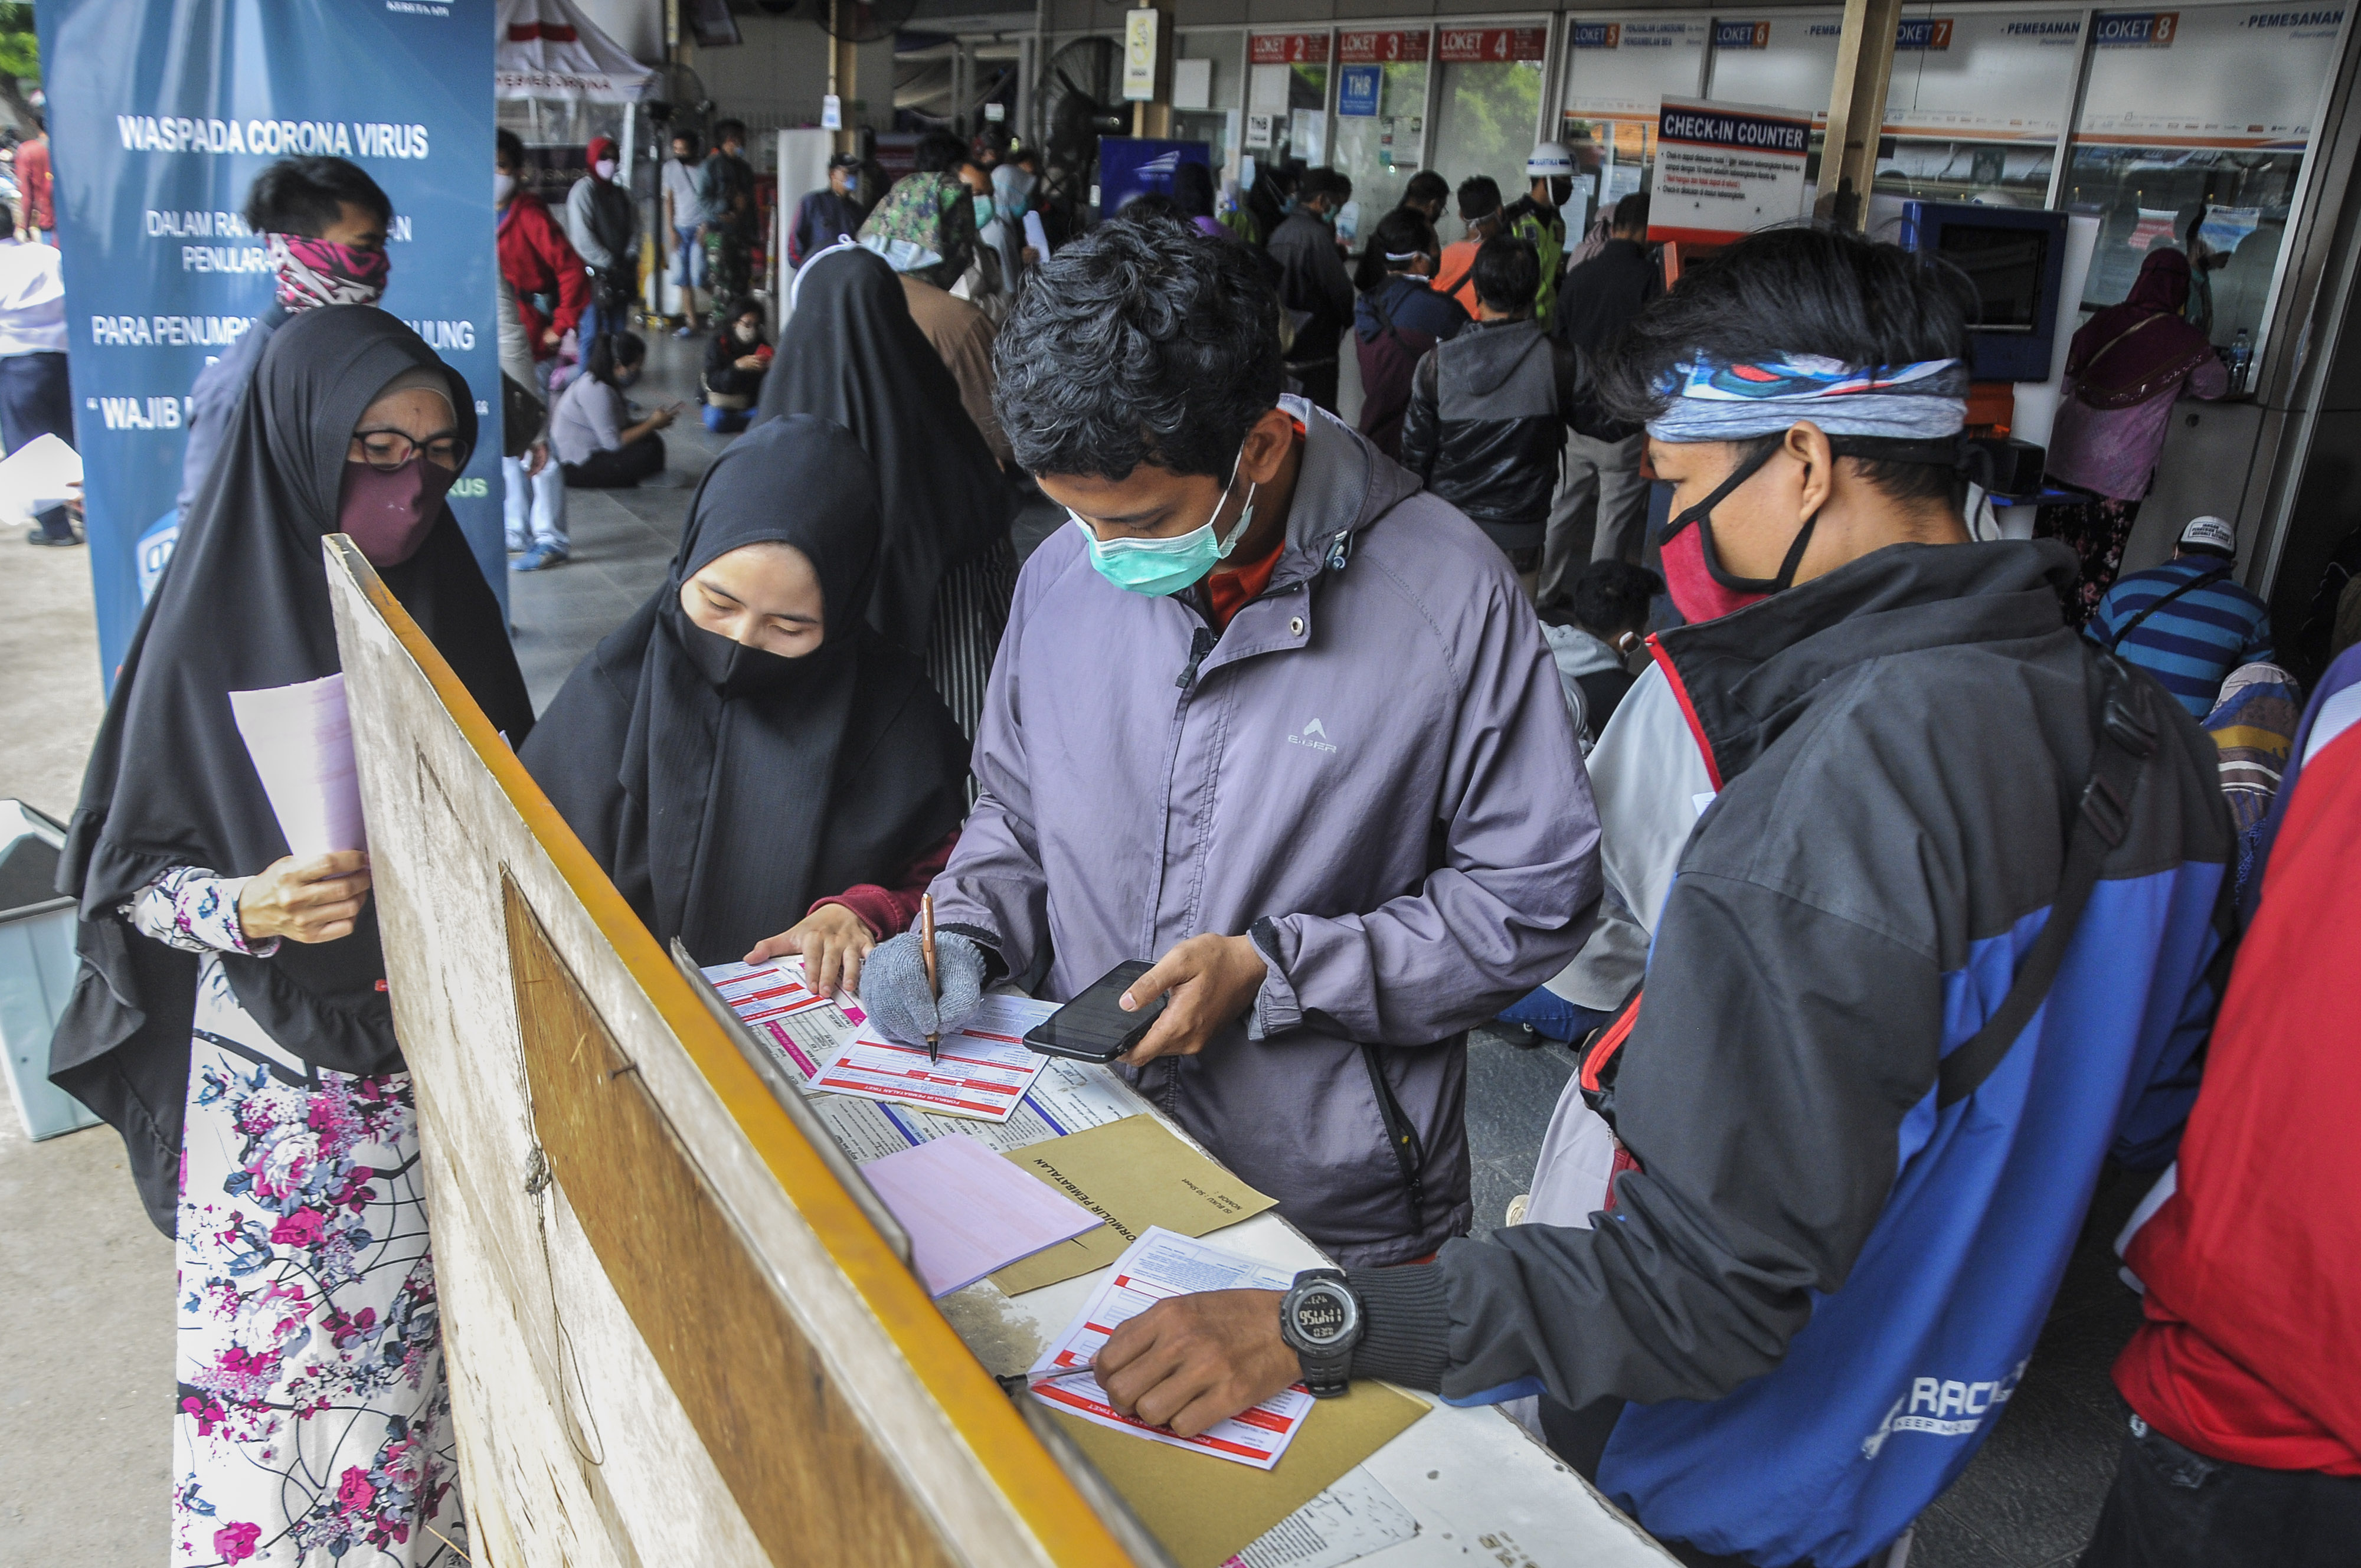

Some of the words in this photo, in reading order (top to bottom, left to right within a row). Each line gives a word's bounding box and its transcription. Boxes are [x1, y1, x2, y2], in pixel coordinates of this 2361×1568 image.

[2007, 22, 2080, 34] PEMESANAN
[2097, 19, 2153, 38] LOKET
[2157, 17, 2172, 40] 8
[2248, 9, 2345, 28] PEMESANAN
[1575, 27, 1605, 41] LOKET
[1608, 25, 1616, 44] 5
[1716, 26, 1752, 40] LOKET
[1757, 25, 1766, 43] 6
[1810, 25, 1842, 35] PEMBA
[1937, 23, 1947, 43] 7
[1253, 36, 1286, 53] LOKET
[1293, 36, 1304, 60] 2
[1341, 34, 1377, 51] LOKET
[1386, 34, 1398, 60] 3
[1441, 32, 1484, 50] LOKET
[1494, 31, 1507, 57] 4
[119, 116, 246, 154] WASPADA
[248, 119, 353, 156] CORONA
[354, 122, 429, 160] VIRUS
[1665, 114, 1734, 141] CHECK-IN
[1738, 122, 1803, 148] COUNTER
[146, 210, 214, 237] DALAM
[91, 316, 153, 346] PARA
[100, 397, 182, 430] WAJIB
[882, 1086, 926, 1099] PEMBATALAN
[926, 1094, 960, 1105] FORMULIR
[1034, 1158, 1095, 1206] PEMBATALAN
[1182, 1179, 1199, 1190] Sheet
[1206, 1197, 1226, 1209] BUKU
[1218, 1194, 1243, 1210] NOMOR
[1091, 1205, 1137, 1243] ORMULIR
[1087, 1403, 1110, 1415] TIKET
